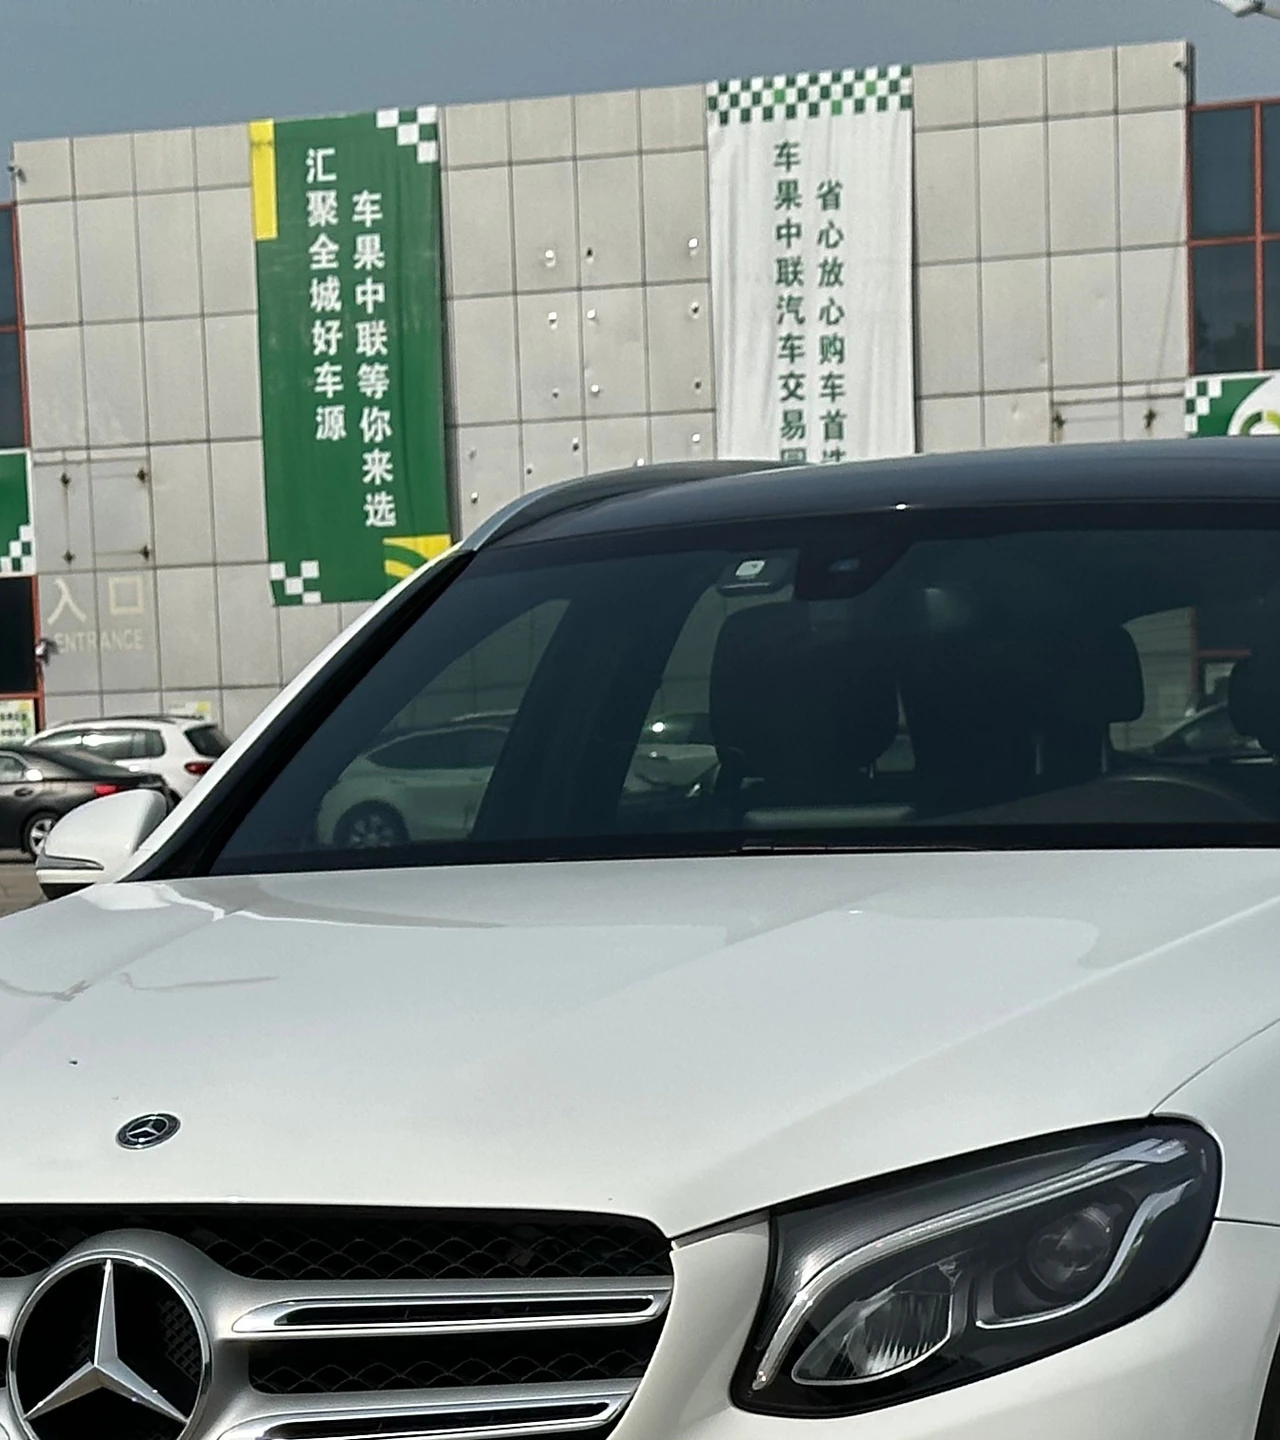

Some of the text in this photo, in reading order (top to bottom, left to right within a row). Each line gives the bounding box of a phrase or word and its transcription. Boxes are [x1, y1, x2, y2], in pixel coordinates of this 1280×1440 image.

[305, 147, 347, 441] 汇聚全城好车源
[352, 190, 397, 528] 车果中联等你来选
[47, 575, 144, 627] 入口
